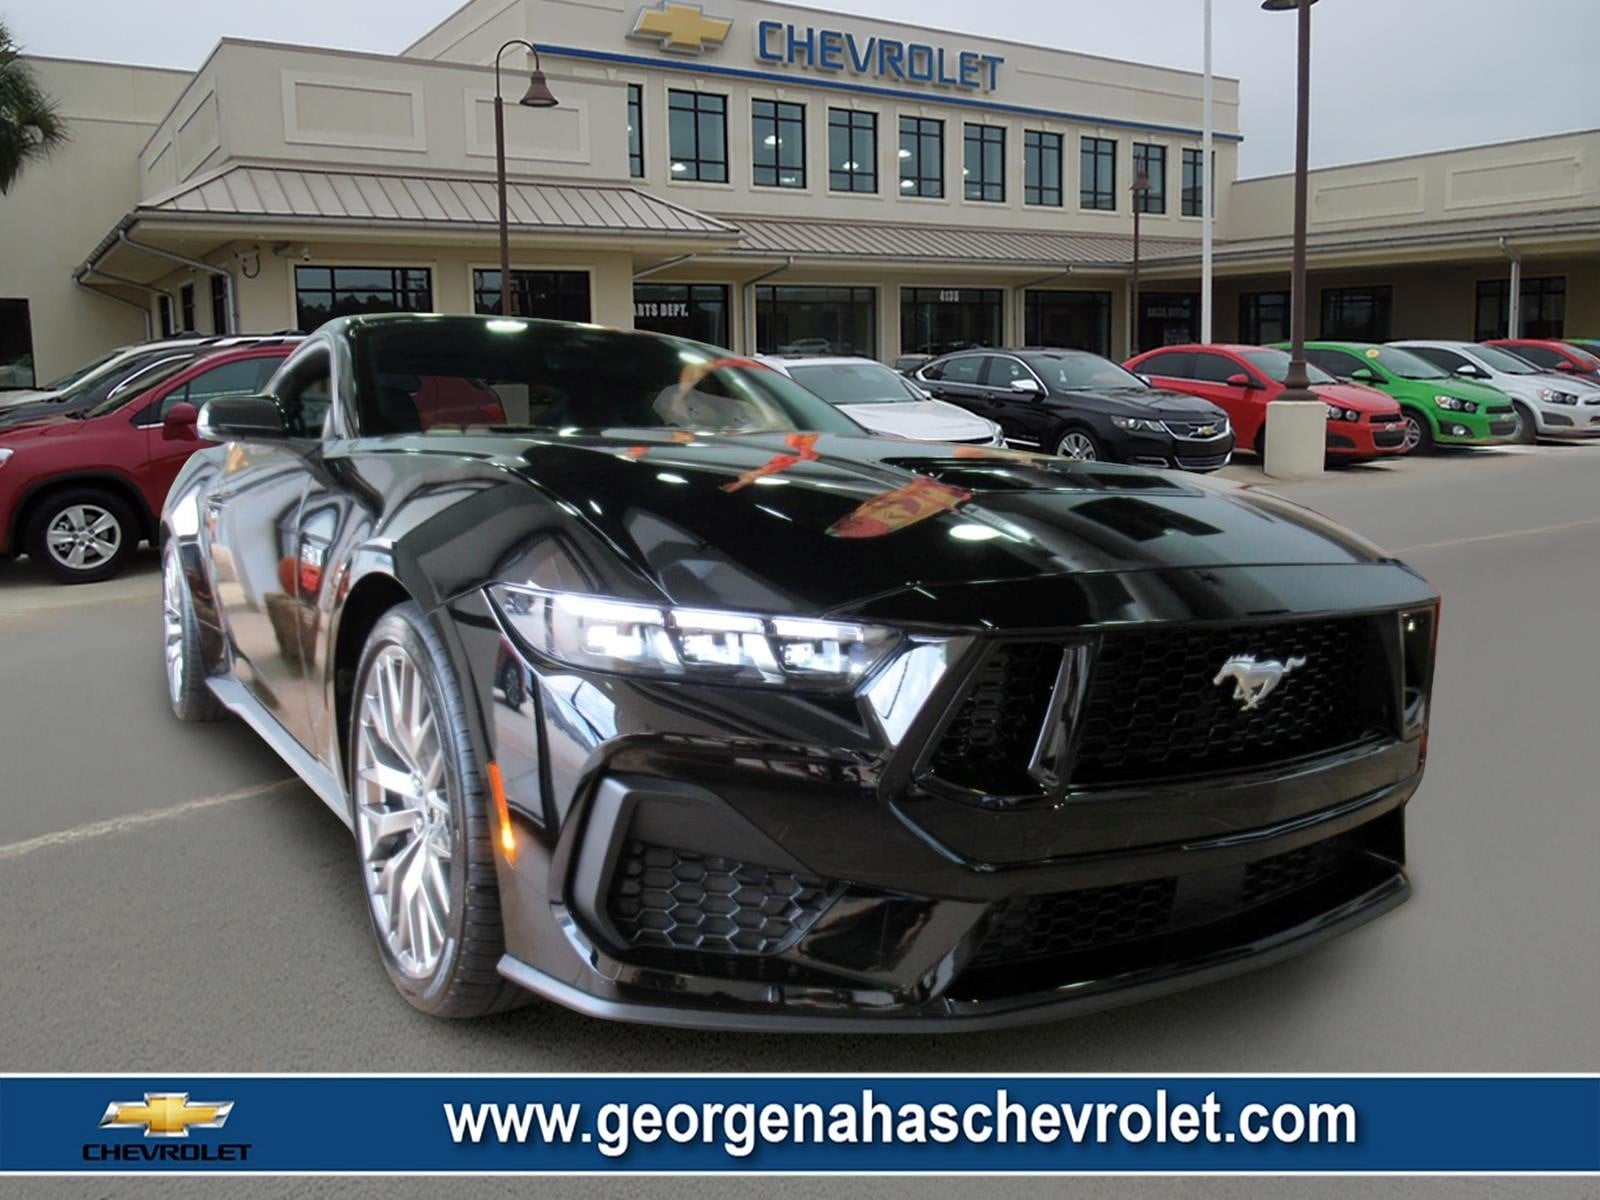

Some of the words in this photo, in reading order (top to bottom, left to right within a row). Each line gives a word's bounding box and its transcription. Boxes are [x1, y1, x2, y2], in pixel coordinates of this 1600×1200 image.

[756, 19, 1005, 91] CHEVROLET
[634, 303, 659, 317] RTS
[660, 303, 689, 317] DEPT.
